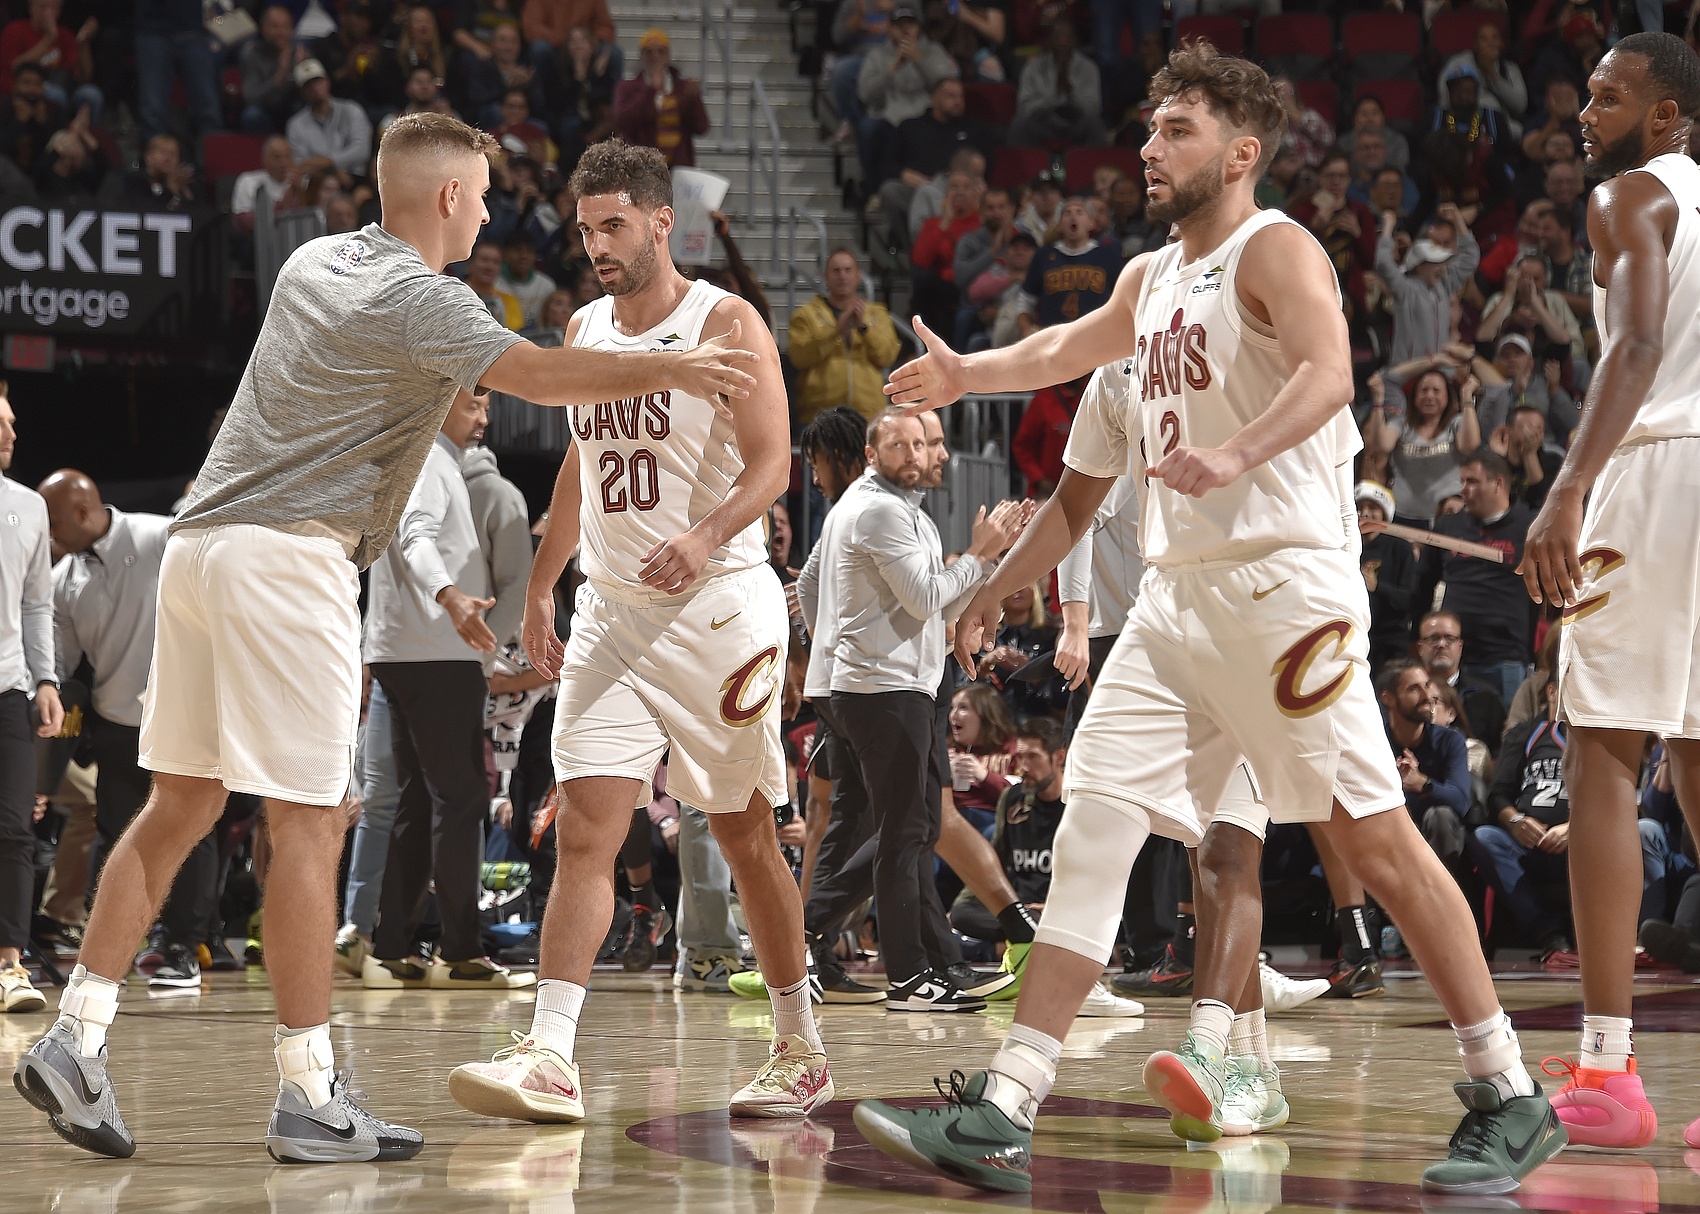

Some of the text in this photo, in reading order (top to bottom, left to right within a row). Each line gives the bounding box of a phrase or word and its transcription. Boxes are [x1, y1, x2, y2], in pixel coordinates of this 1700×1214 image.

[0, 205, 192, 278] CKET
[0, 279, 130, 327] rtgage
[1192, 282, 1221, 294] CLIFFS
[1137, 322, 1212, 402] CAVS
[573, 390, 671, 441] CAVS
[1160, 410, 1180, 457] 2
[599, 448, 661, 514] 20
